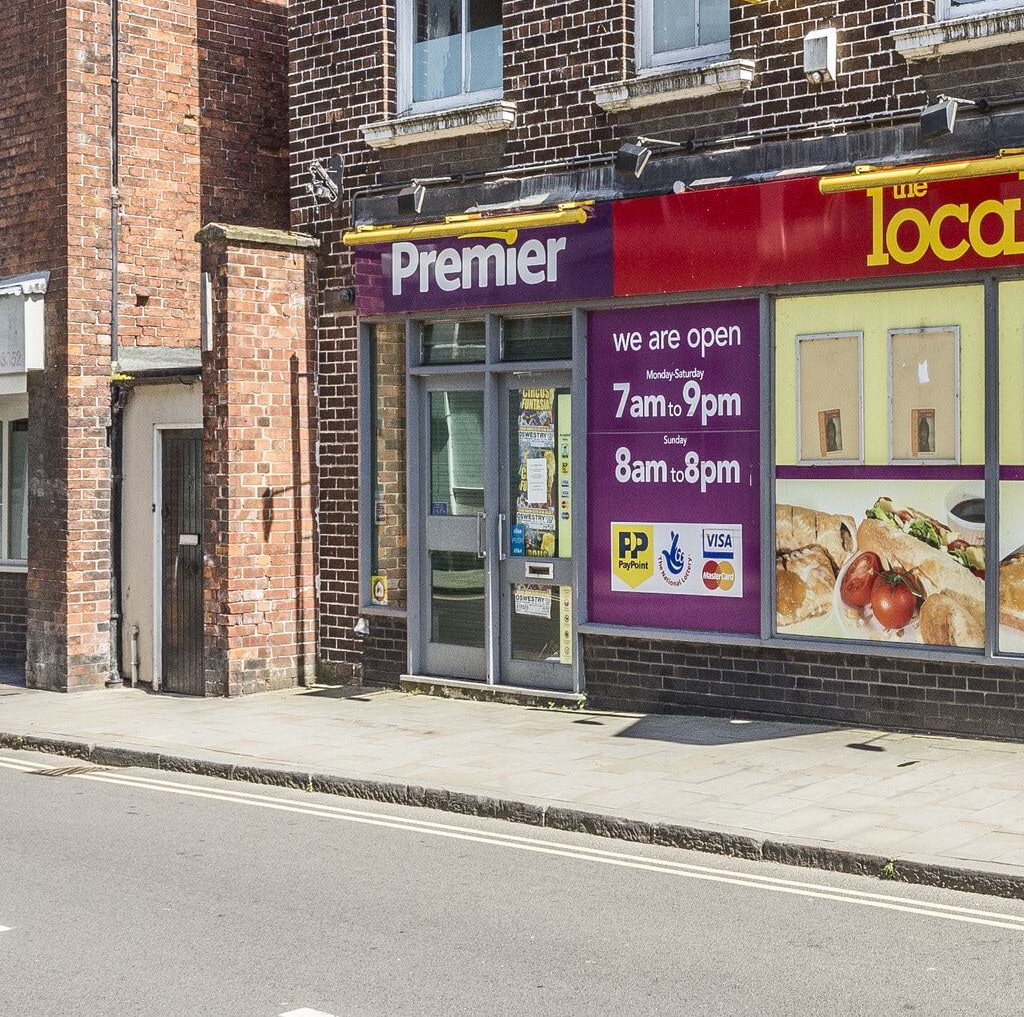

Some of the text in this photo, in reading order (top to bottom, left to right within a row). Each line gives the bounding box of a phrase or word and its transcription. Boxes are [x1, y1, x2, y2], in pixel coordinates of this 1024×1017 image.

[392, 237, 567, 296] Premier
[613, 325, 741, 358] we are open
[646, 368, 705, 381] Monday-Saturday
[613, 380, 741, 426] 7am to 9pm
[663, 435, 687, 446] Sunday
[615, 446, 740, 493] 8am to 8pm
[706, 533, 732, 547] VISA
[618, 560, 648, 571] PayPoint
[661, 569, 681, 587] National
[682, 557, 692, 583] Lottery
[703, 571, 735, 582] MasterCard
[516, 594, 544, 603] OSWESTRY
